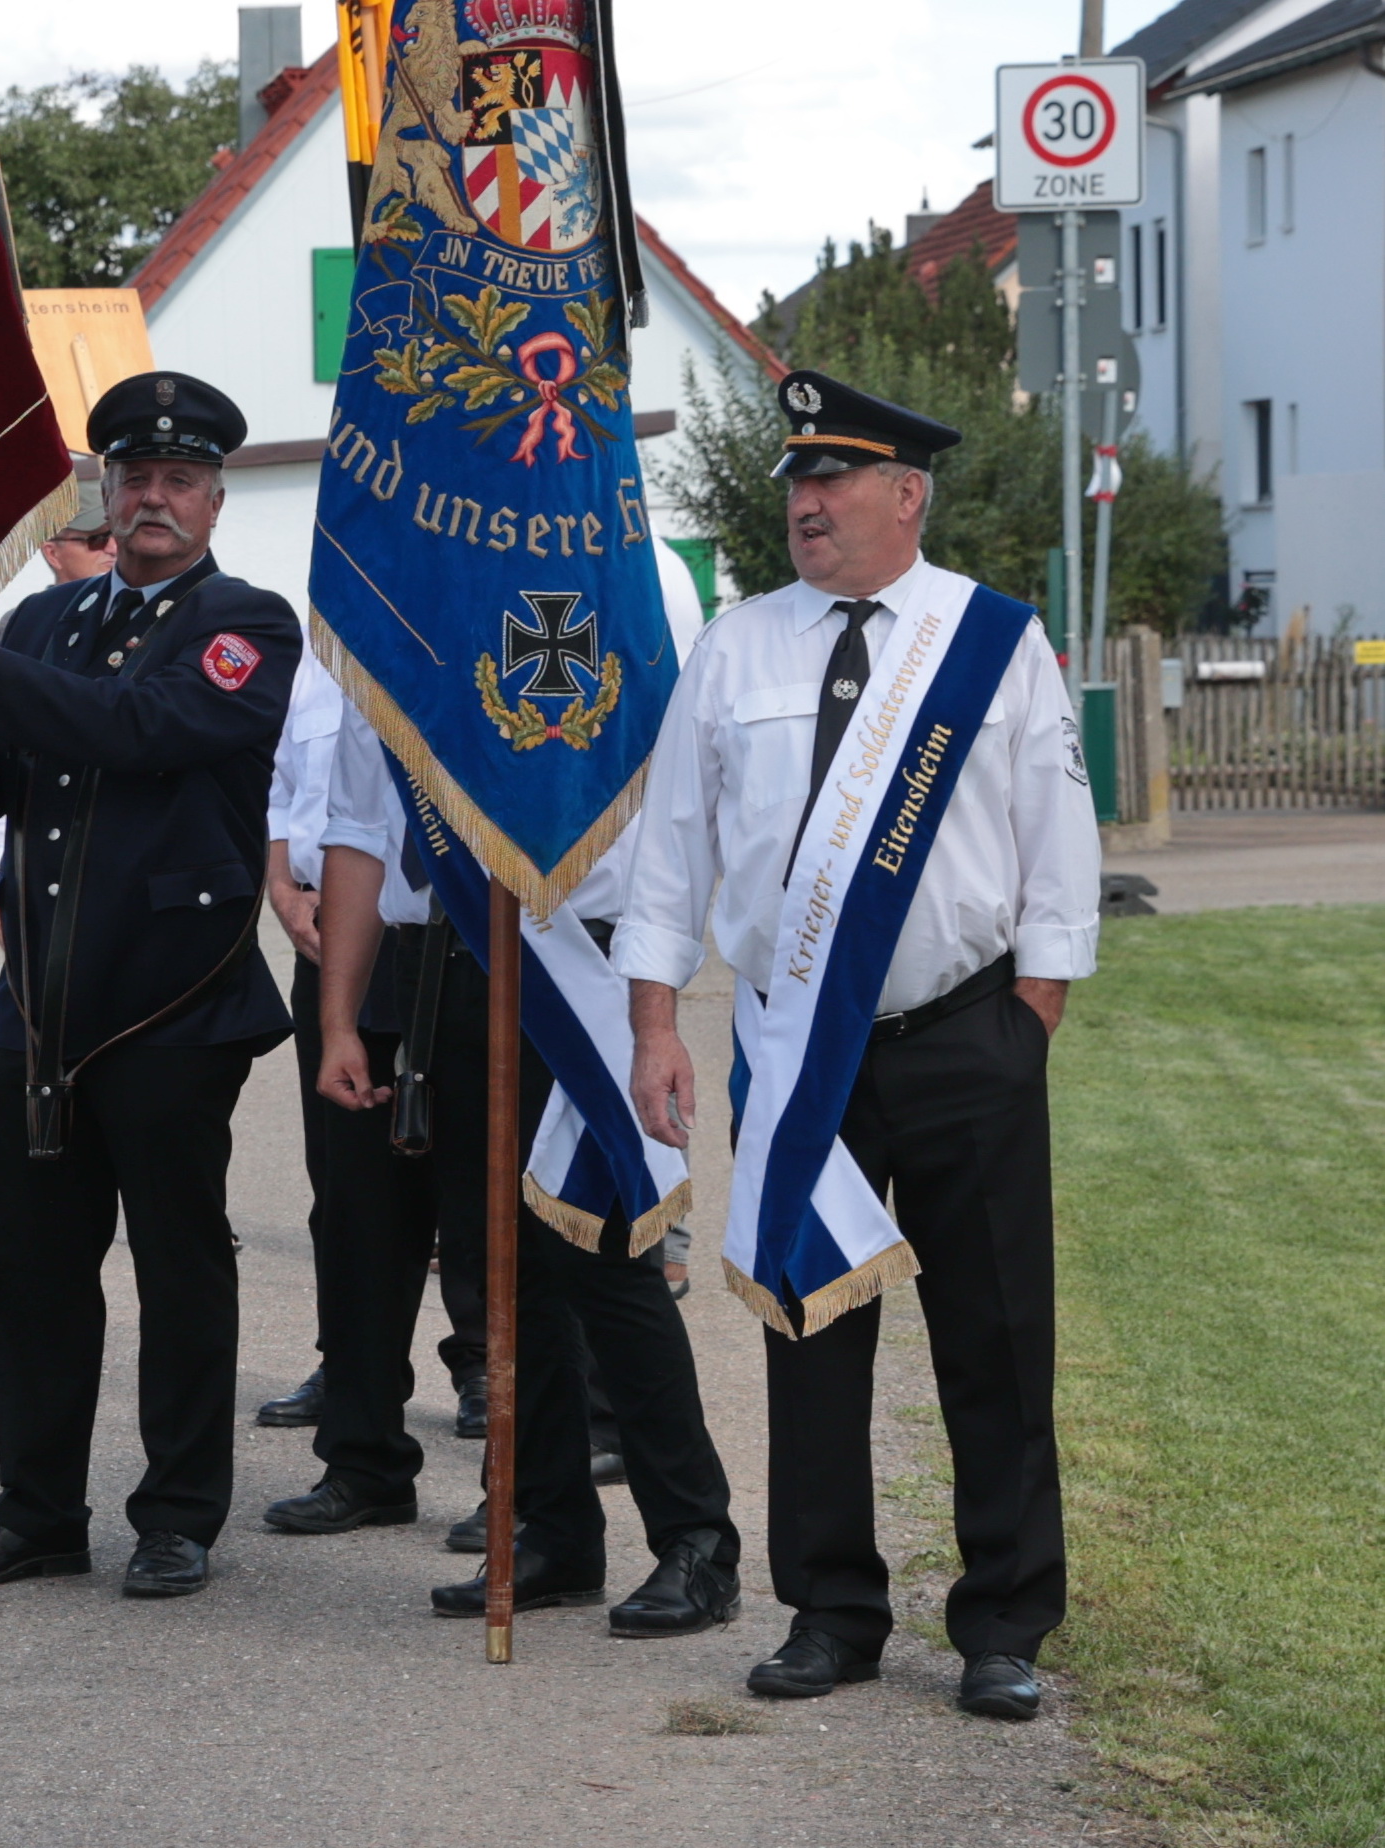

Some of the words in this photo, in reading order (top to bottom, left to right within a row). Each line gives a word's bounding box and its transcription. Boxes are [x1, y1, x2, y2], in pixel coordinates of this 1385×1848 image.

[1042, 100, 1095, 141] 30
[1033, 173, 1106, 197] ZONE
[482, 249, 570, 291] TREUE
[29, 300, 130, 315] tensheim
[327, 406, 404, 501] und
[413, 482, 604, 558] unsere
[787, 858, 836, 985] Krieger-
[828, 781, 864, 850] und
[849, 611, 942, 786] Soldatenverein
[872, 722, 953, 876] Eitensheim
